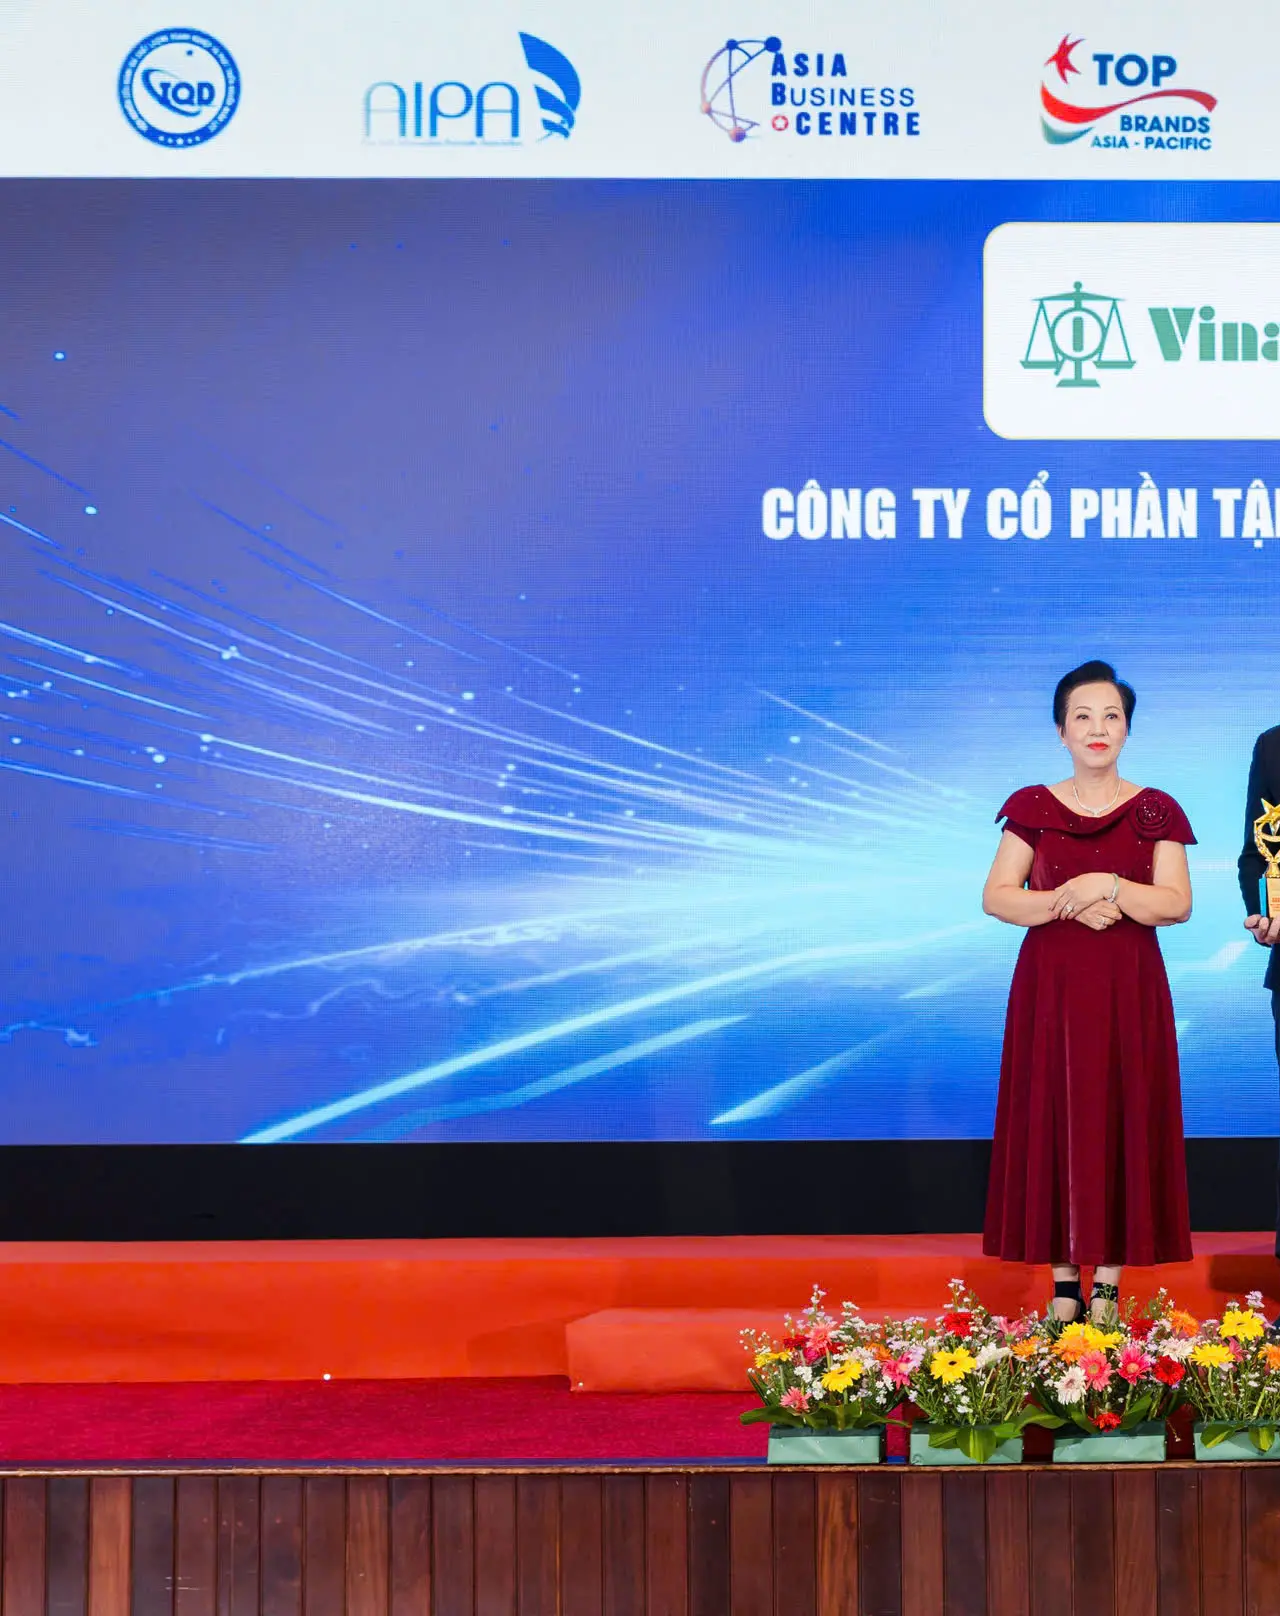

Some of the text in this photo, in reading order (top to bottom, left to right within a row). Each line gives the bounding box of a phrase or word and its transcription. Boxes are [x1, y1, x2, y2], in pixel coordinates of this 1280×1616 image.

[771, 53, 847, 77] ASIA
[1092, 53, 1177, 87] TOP
[771, 82, 915, 107] BUSINESS
[362, 81, 520, 138] AIPA
[795, 111, 920, 136] CENTRE
[1119, 114, 1211, 134] BRANDS
[1091, 135, 1130, 149] ASIA
[1144, 136, 1212, 151] PACIFIC
[762, 479, 897, 541] CÔNG
[912, 487, 971, 540] TY
[986, 470, 1053, 541] CỔ
[1070, 472, 1198, 540] PHẦN
